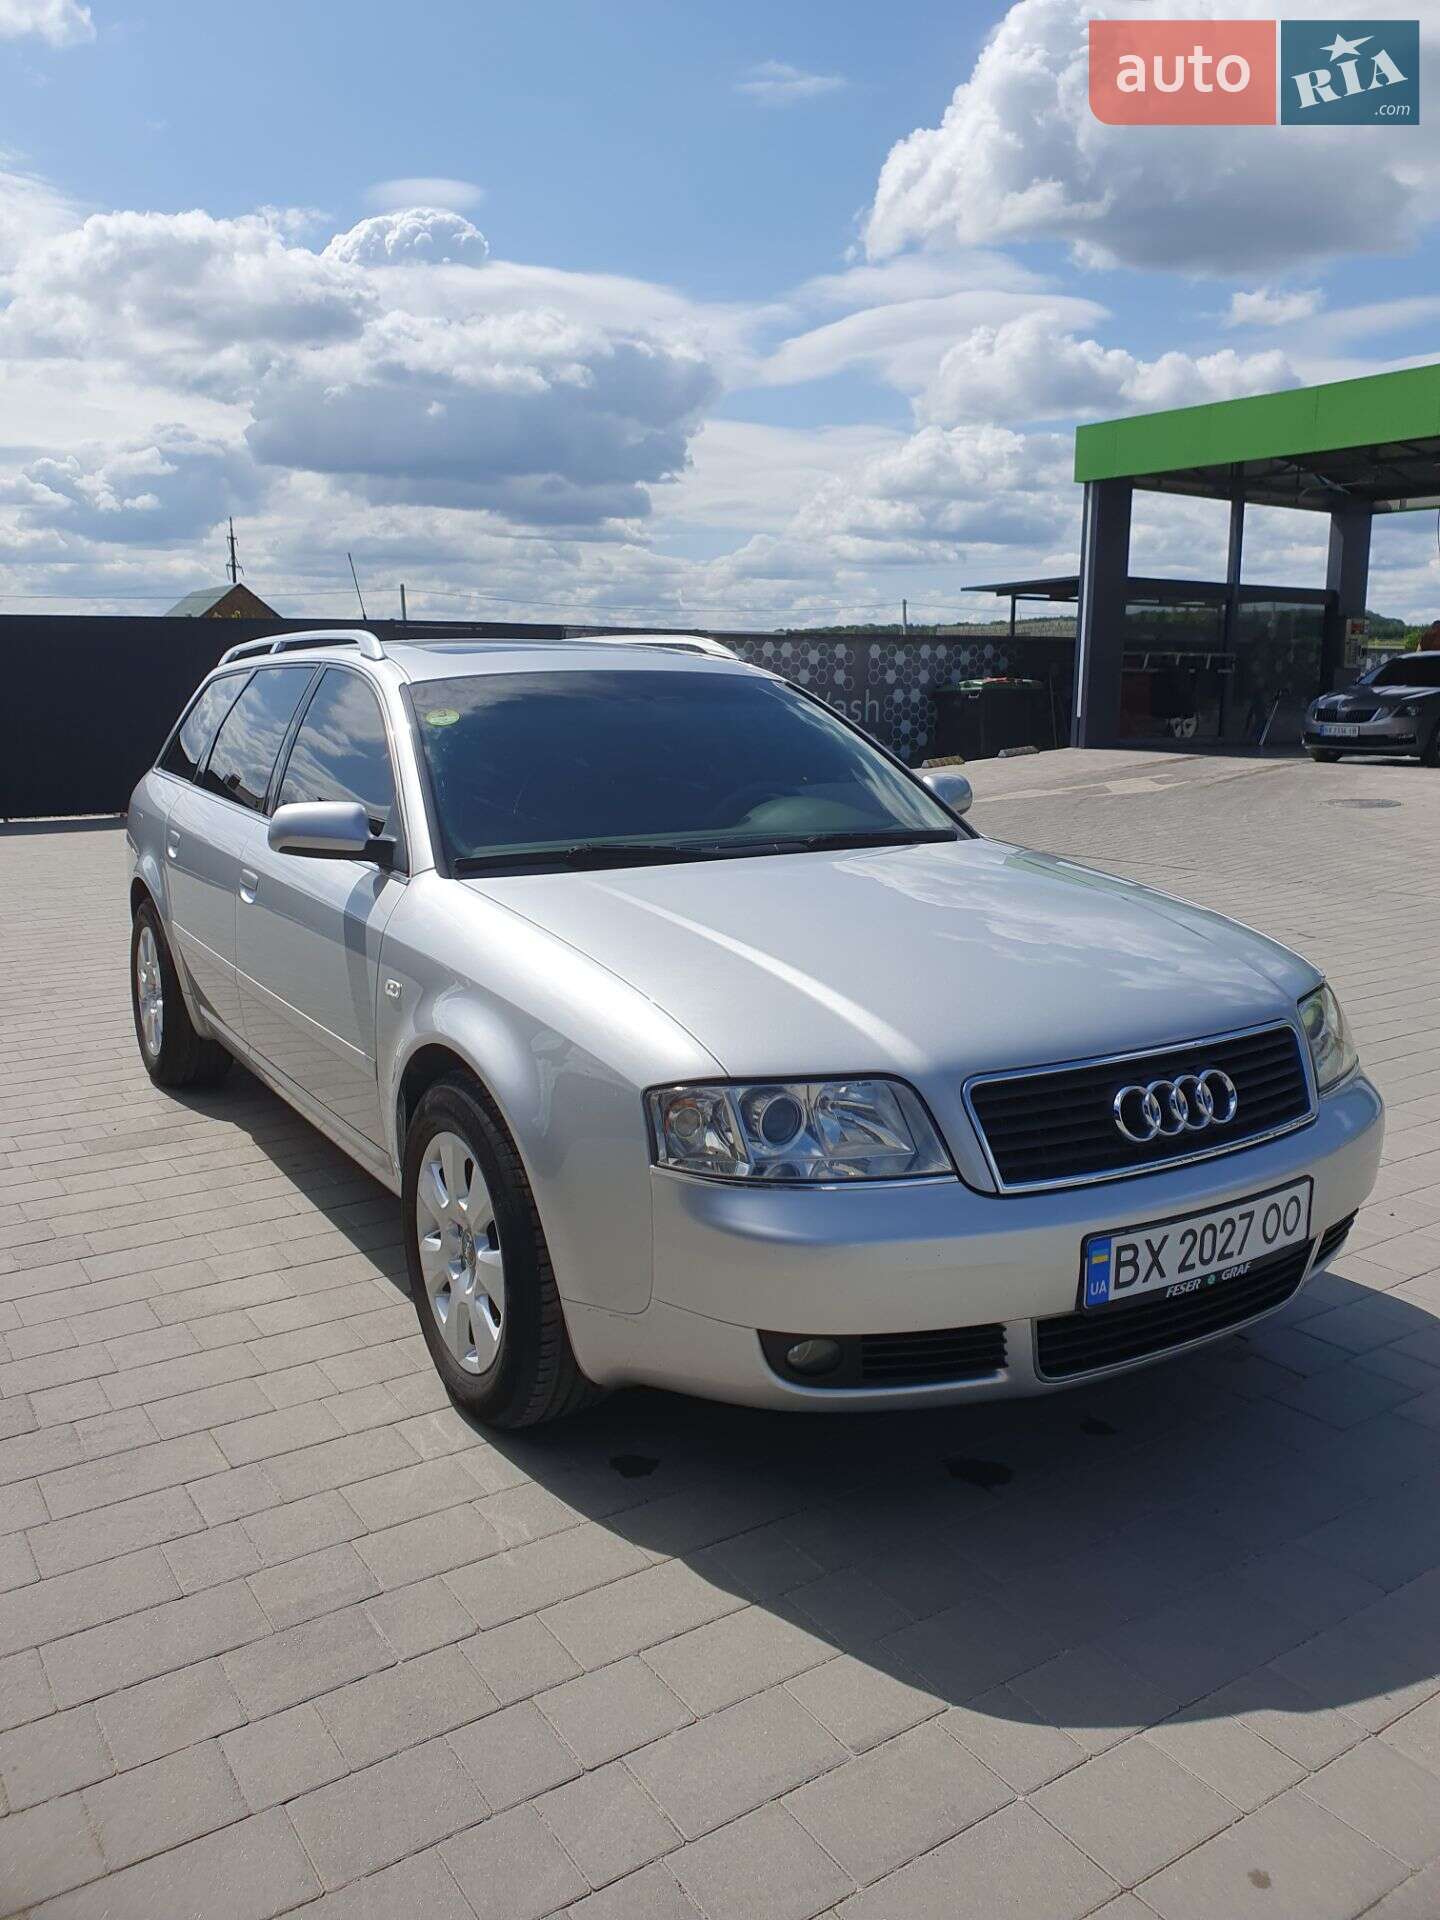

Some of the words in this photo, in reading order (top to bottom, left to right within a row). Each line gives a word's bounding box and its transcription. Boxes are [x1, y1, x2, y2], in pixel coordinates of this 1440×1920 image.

[815, 689, 879, 723] ash
[1113, 1234, 1169, 1290] BX
[1177, 1210, 1255, 1274] 2027
[1221, 1261, 1252, 1281] GRAF
[1090, 1280, 1108, 1295] UA
